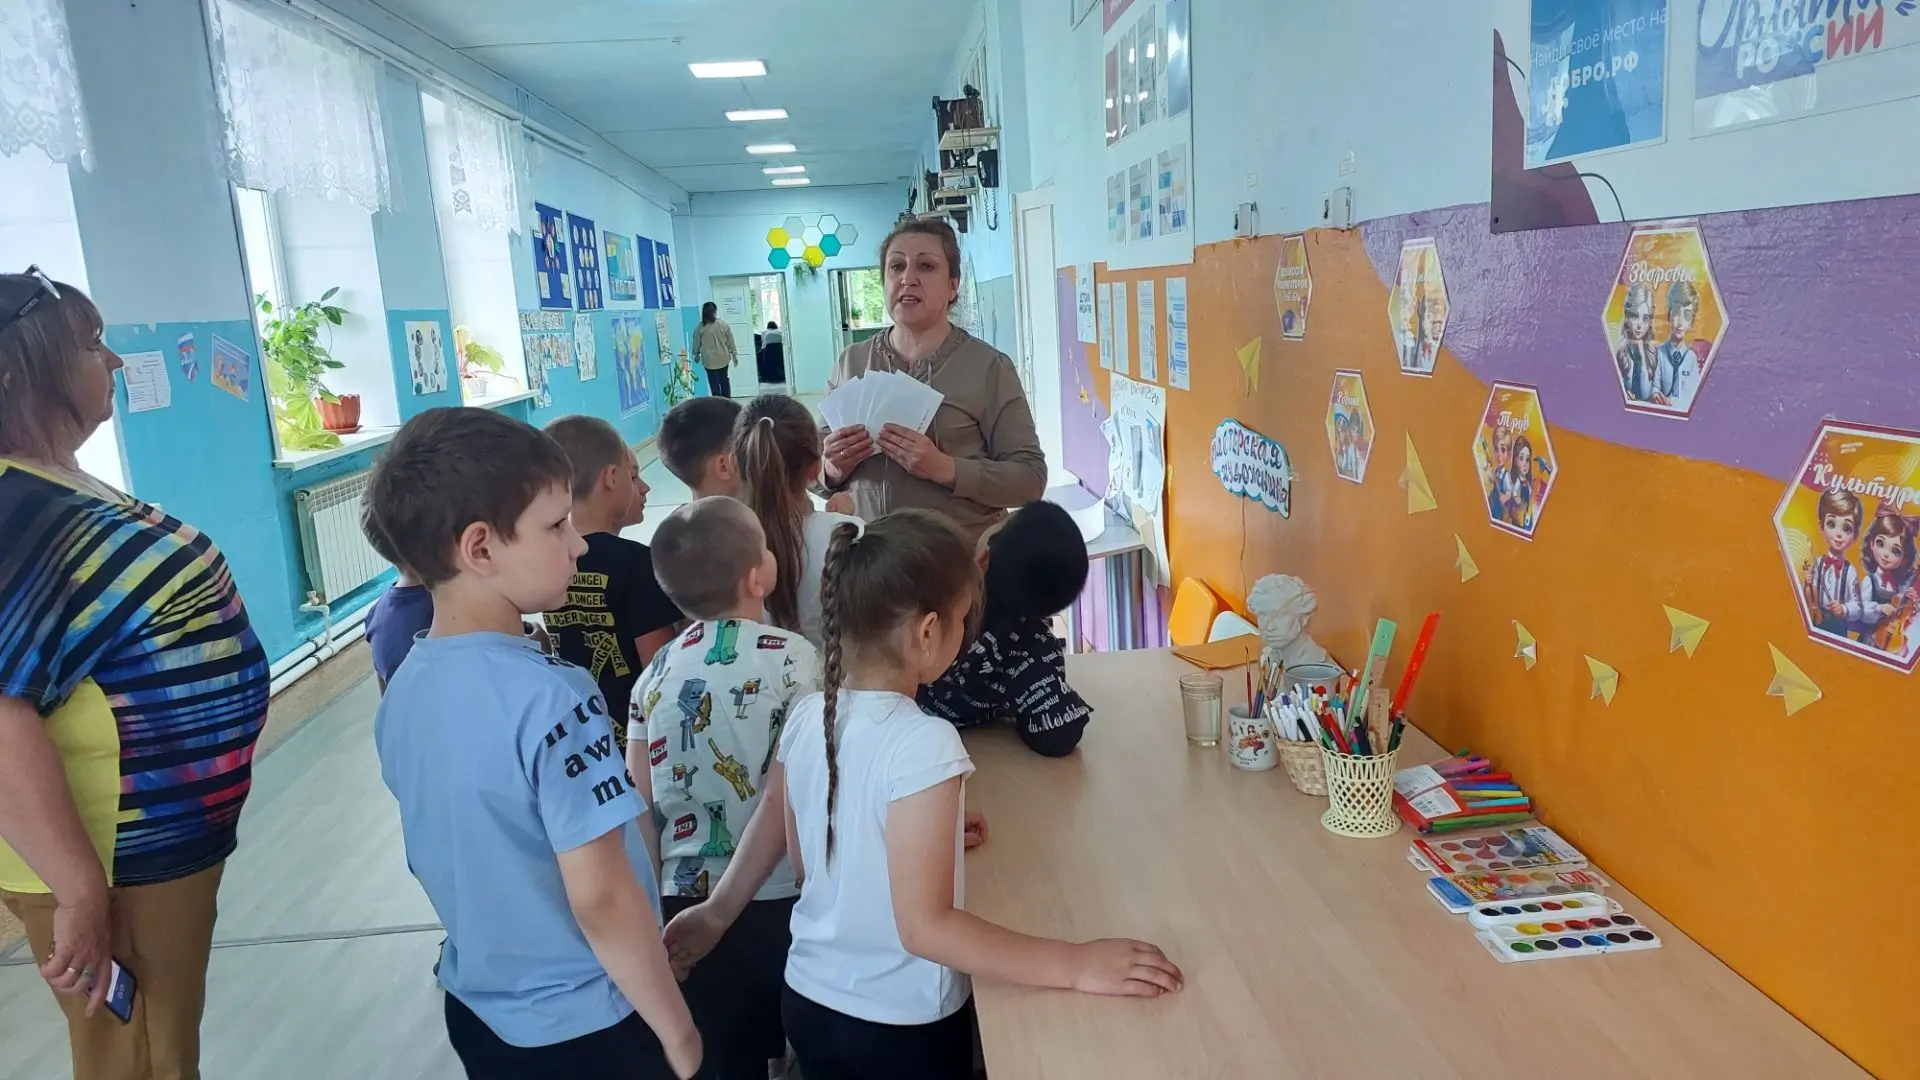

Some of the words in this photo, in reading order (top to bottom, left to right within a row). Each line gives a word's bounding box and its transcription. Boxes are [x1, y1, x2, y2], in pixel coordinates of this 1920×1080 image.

[1571, 29, 1600, 55] своё
[1603, 17, 1645, 44] место
[1497, 411, 1529, 433] Труд
